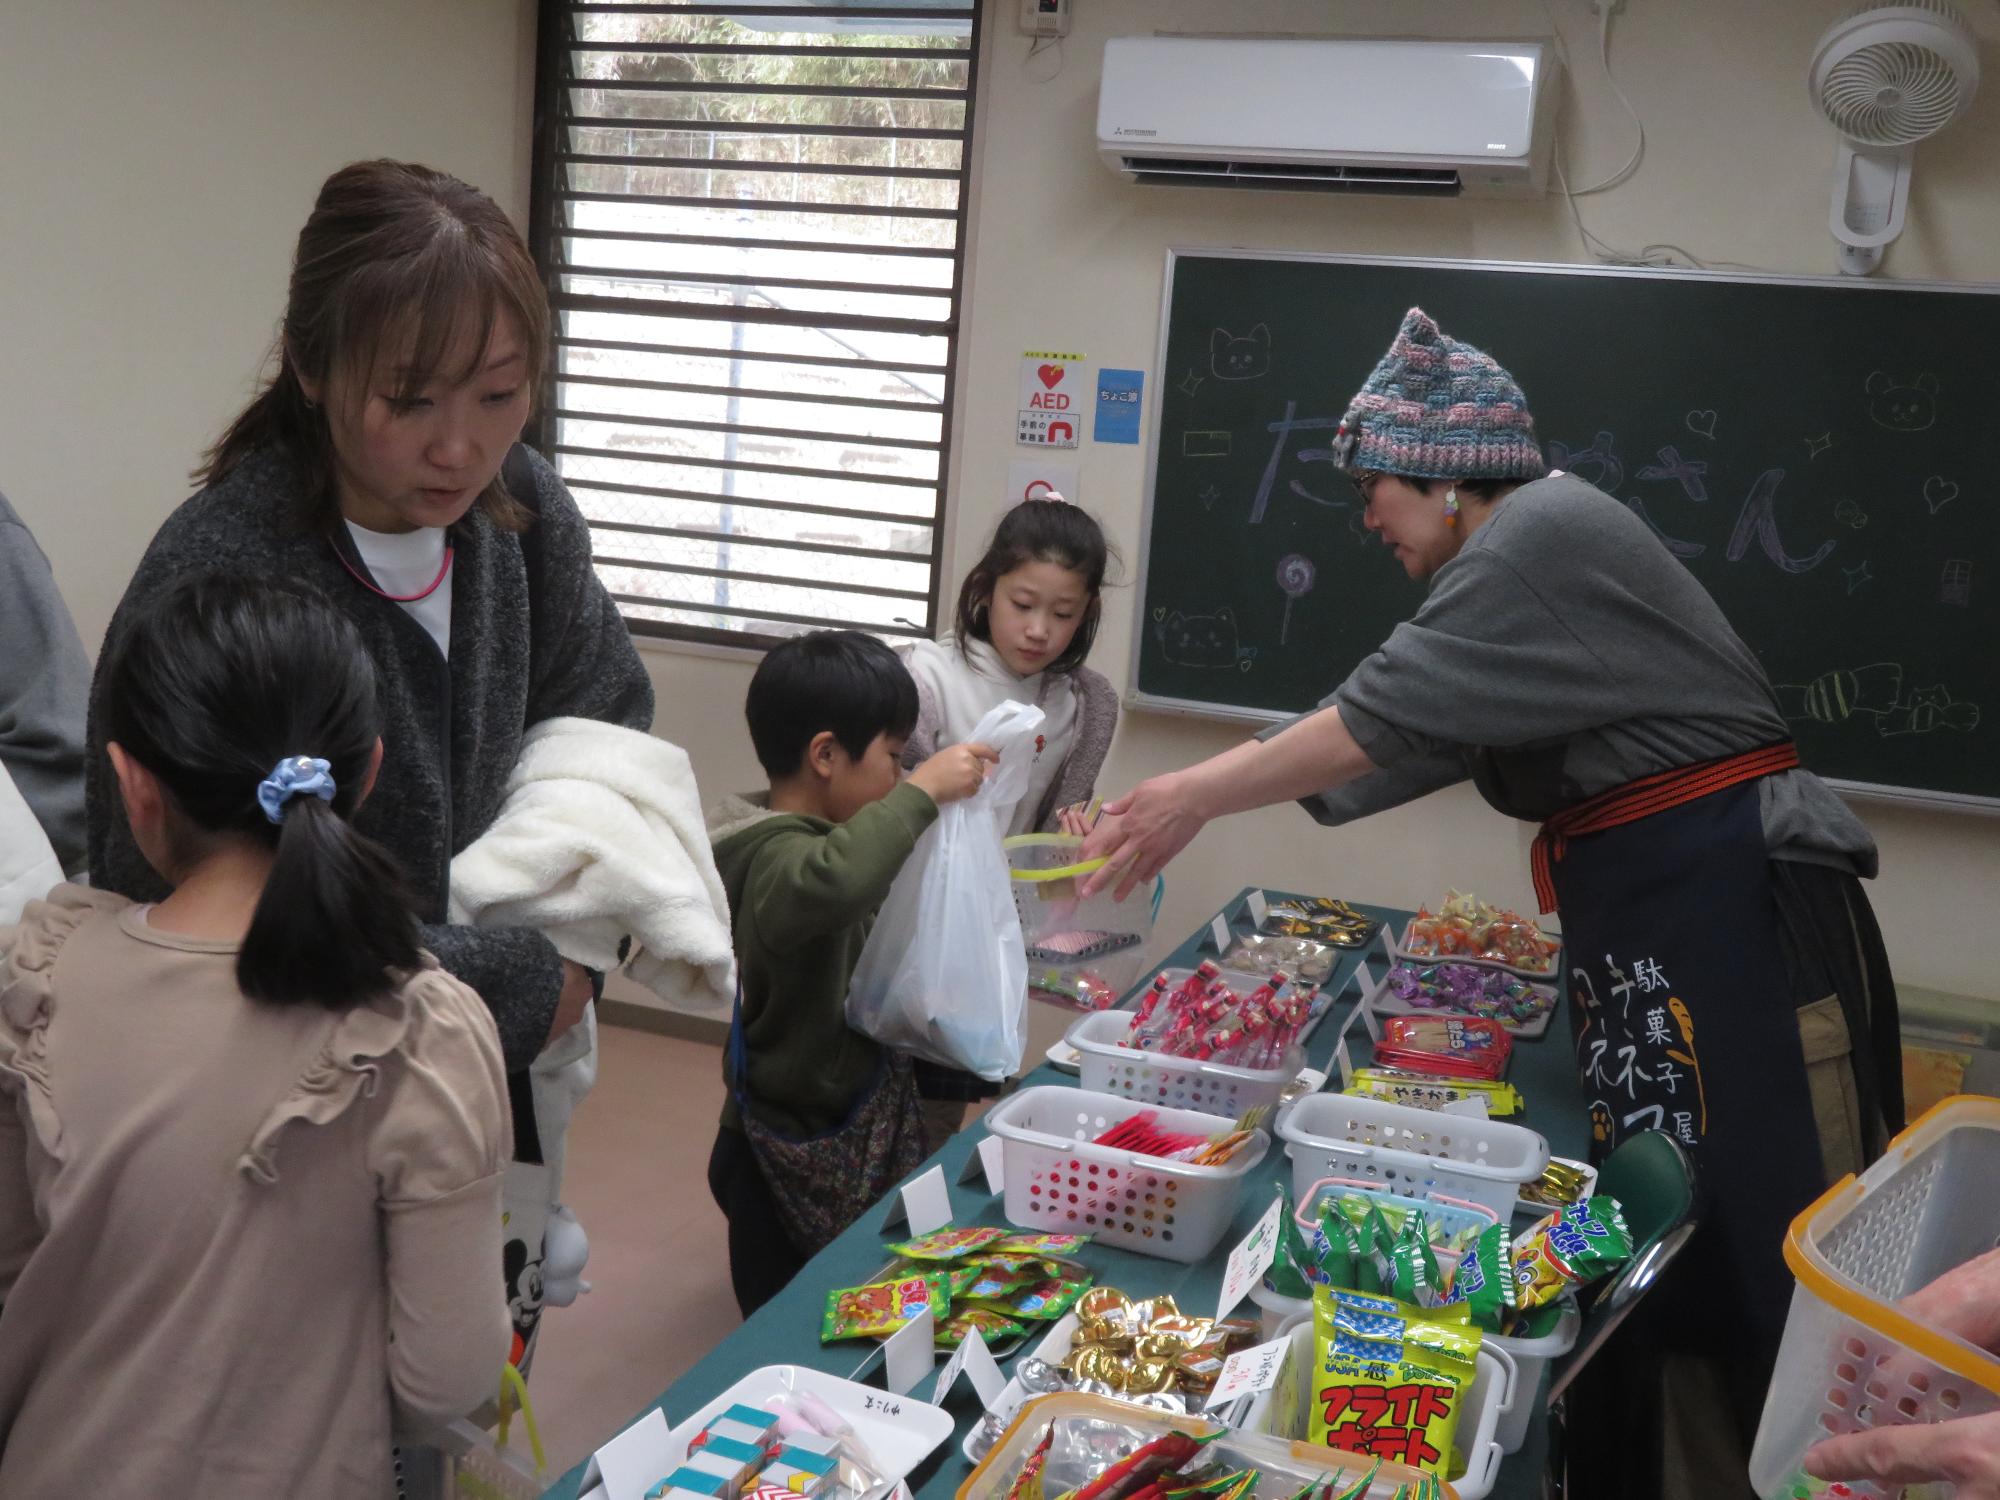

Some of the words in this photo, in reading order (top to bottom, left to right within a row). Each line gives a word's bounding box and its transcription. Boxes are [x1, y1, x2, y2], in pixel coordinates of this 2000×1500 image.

[1029, 391, 1071, 411] AED
[1633, 957, 1698, 1145] 駄菓子屋
[1319, 1384, 1455, 1429] フライド
[1326, 1421, 1442, 1468] ポテト
